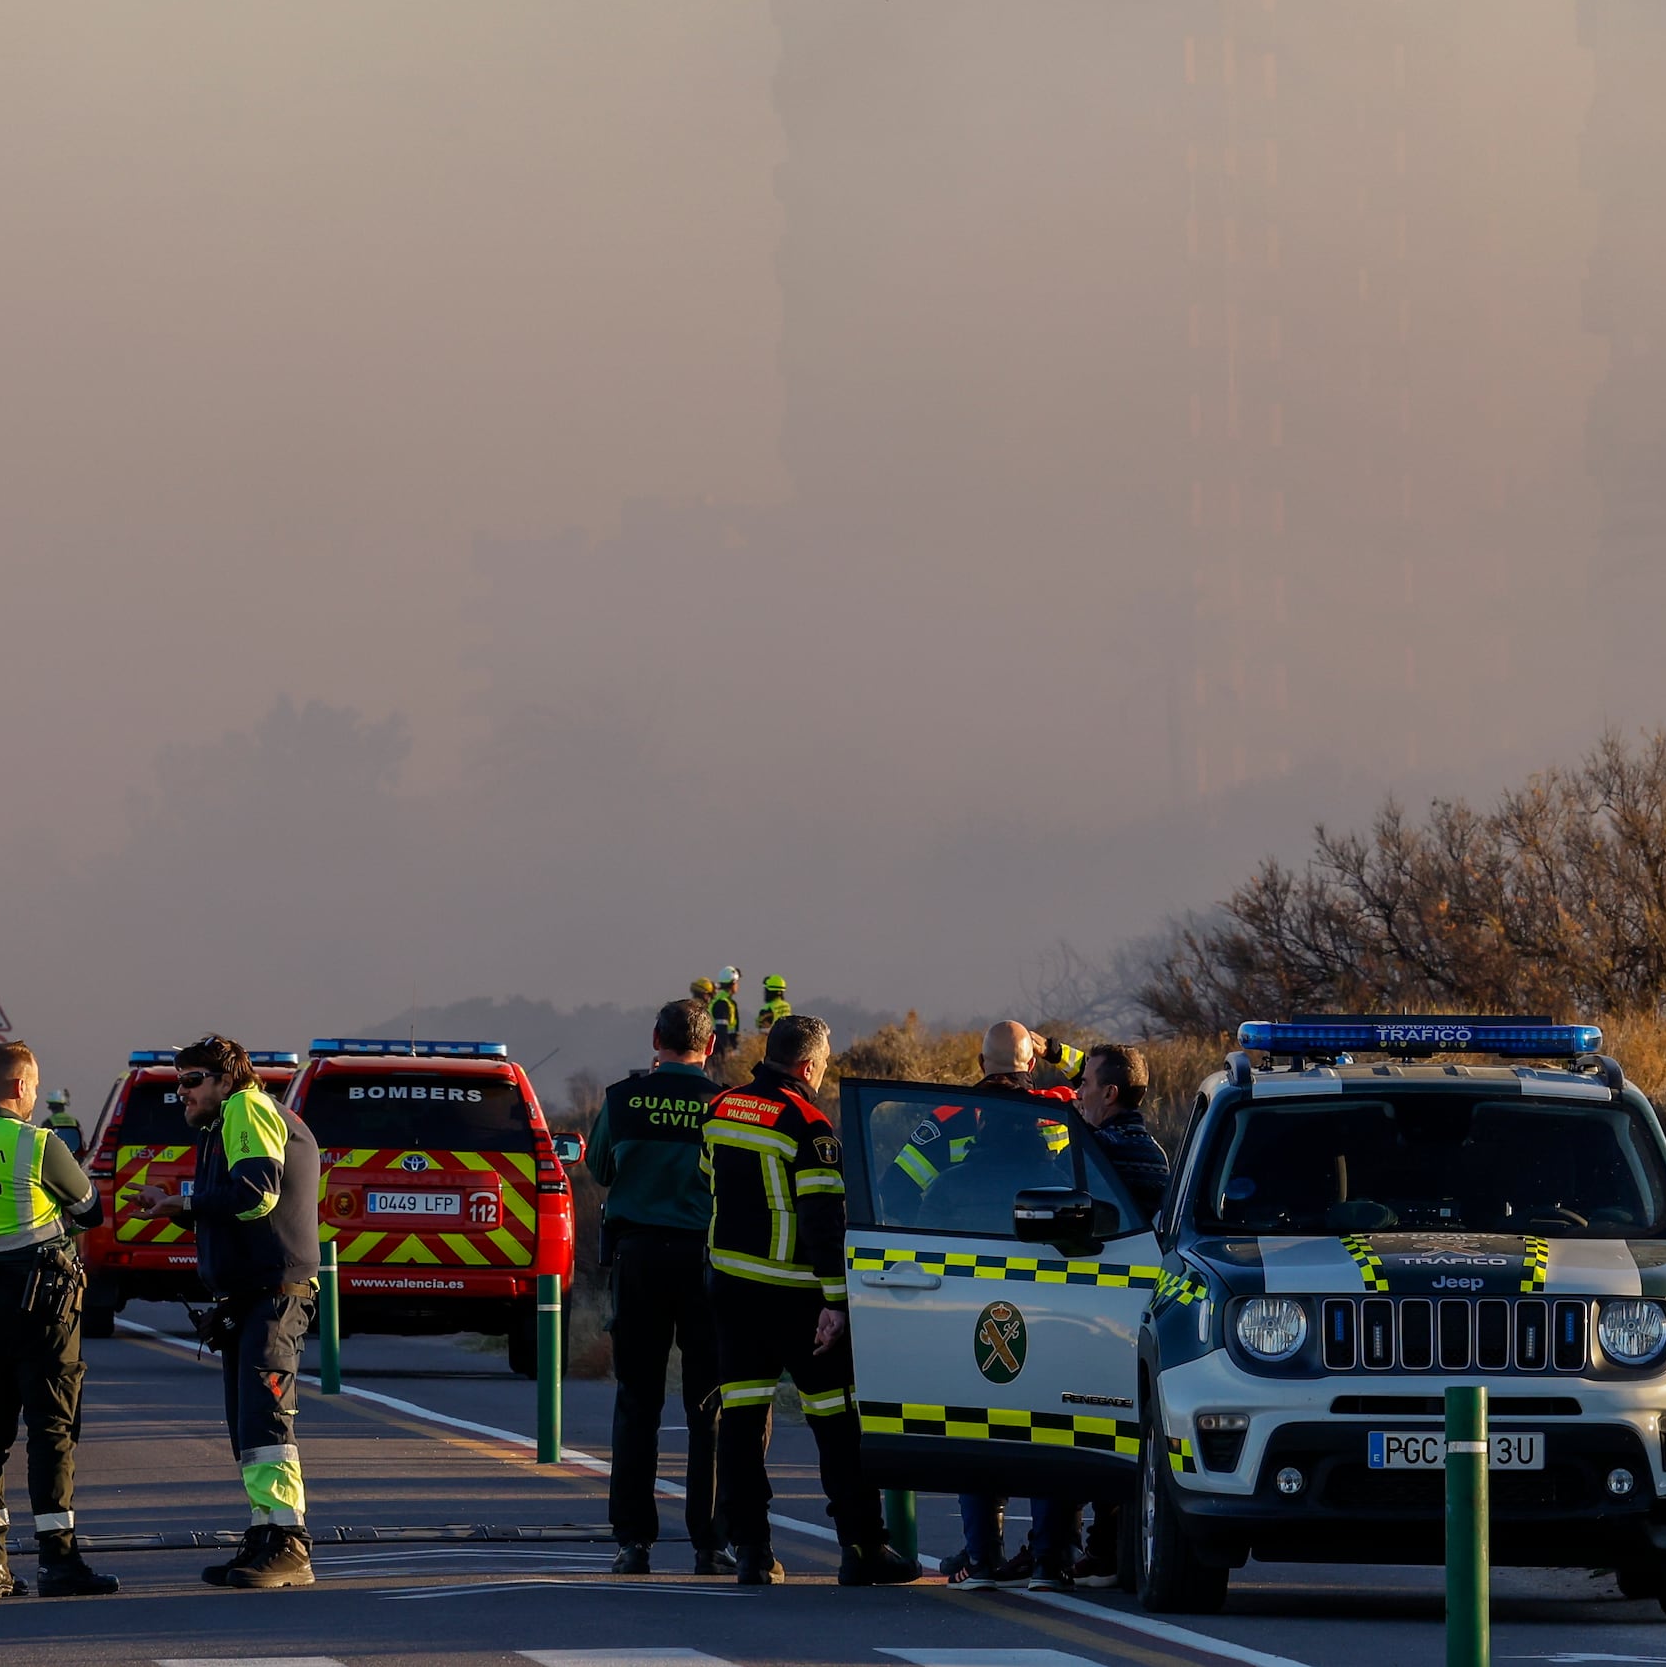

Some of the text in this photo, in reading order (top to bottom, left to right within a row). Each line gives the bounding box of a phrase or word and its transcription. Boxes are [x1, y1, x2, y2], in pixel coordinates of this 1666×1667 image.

[1376, 1029, 1472, 1042] TRAFICO
[349, 1086, 483, 1103] BOMBERS
[628, 1095, 709, 1116] GUARDI
[758, 1102, 781, 1115] CIVIL
[649, 1111, 700, 1130] CIVIL
[161, 1148, 174, 1160] 16
[378, 1195, 454, 1213] 0449 LFP
[469, 1204, 497, 1222] 112
[350, 1277, 465, 1290] www.valencia.es
[1431, 1275, 1485, 1292] Jeep
[1061, 1391, 1134, 1409] RENEGADE
